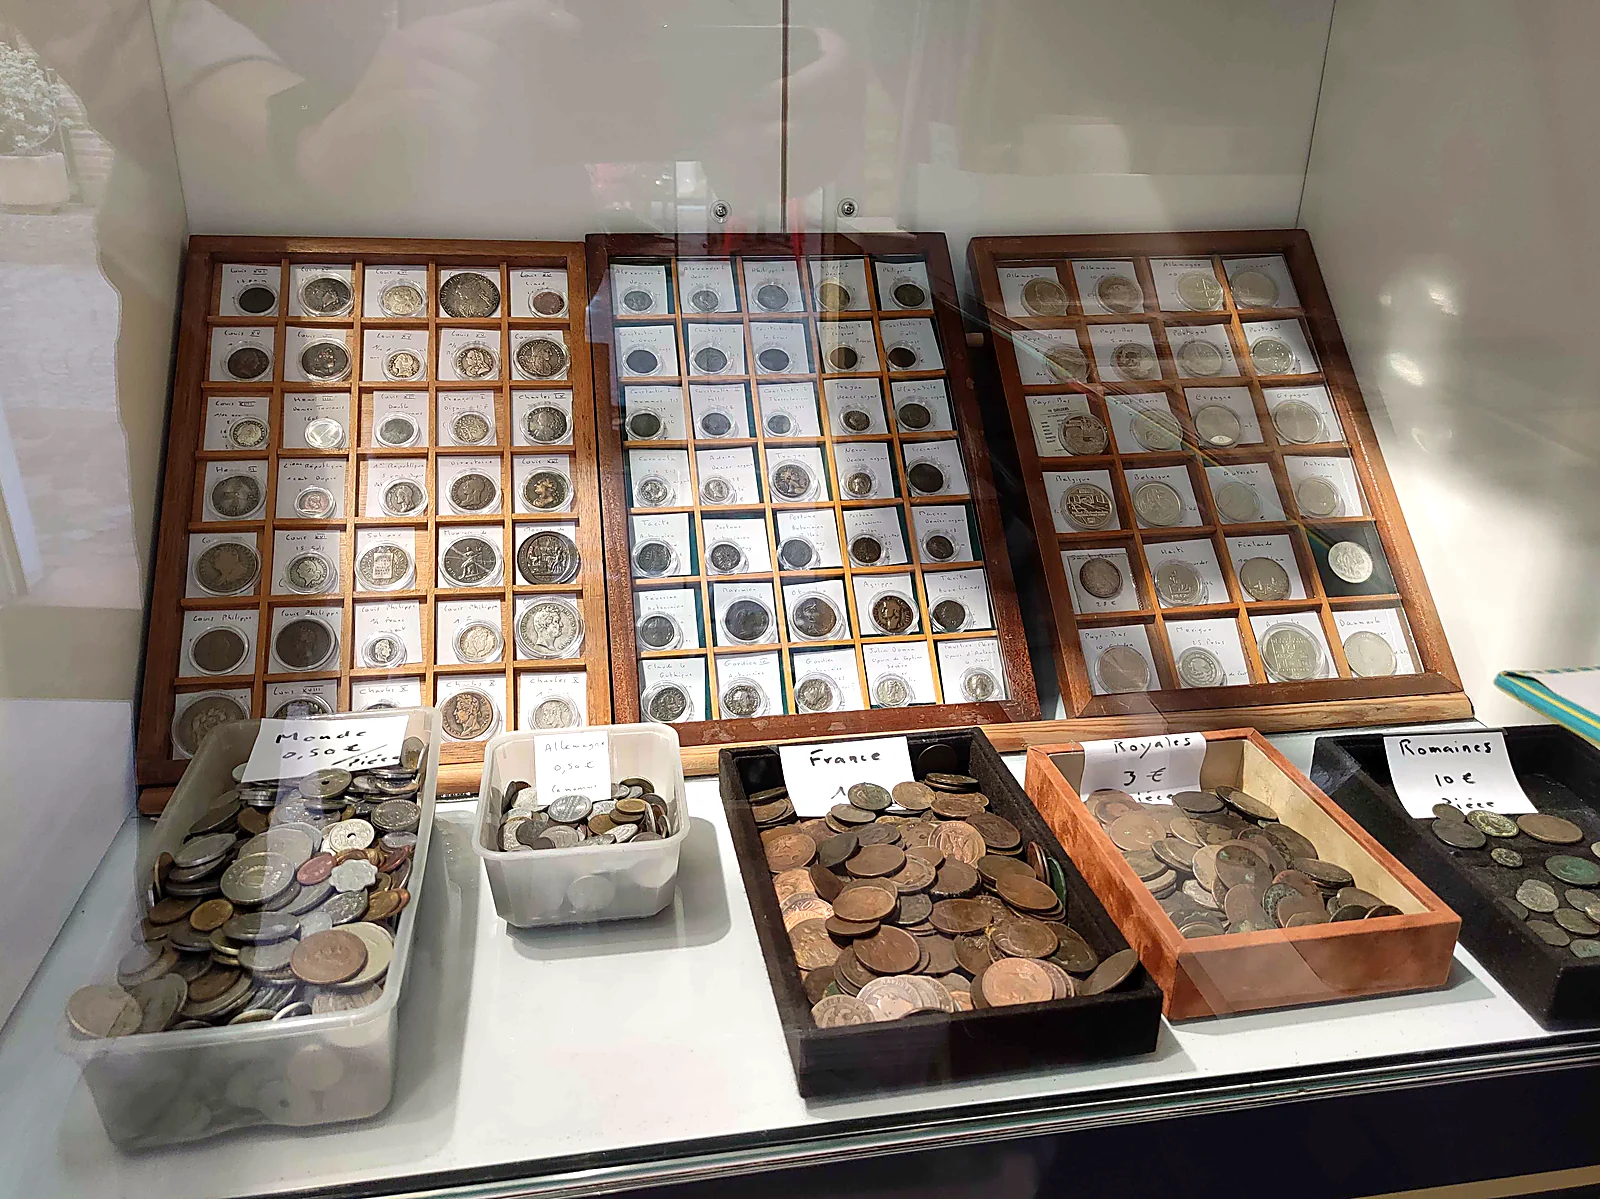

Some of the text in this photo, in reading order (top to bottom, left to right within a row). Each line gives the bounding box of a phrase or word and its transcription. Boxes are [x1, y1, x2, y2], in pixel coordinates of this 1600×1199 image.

[275, 730, 367, 743] Monde
[544, 740, 605, 752] Allemagne
[1114, 737, 1191, 759] Royales
[1399, 738, 1492, 756] Romaines
[810, 748, 881, 766] France
[1123, 767, 1167, 786] 3 €
[1434, 772, 1476, 787] 10 €
[1137, 791, 1174, 802] ièce
